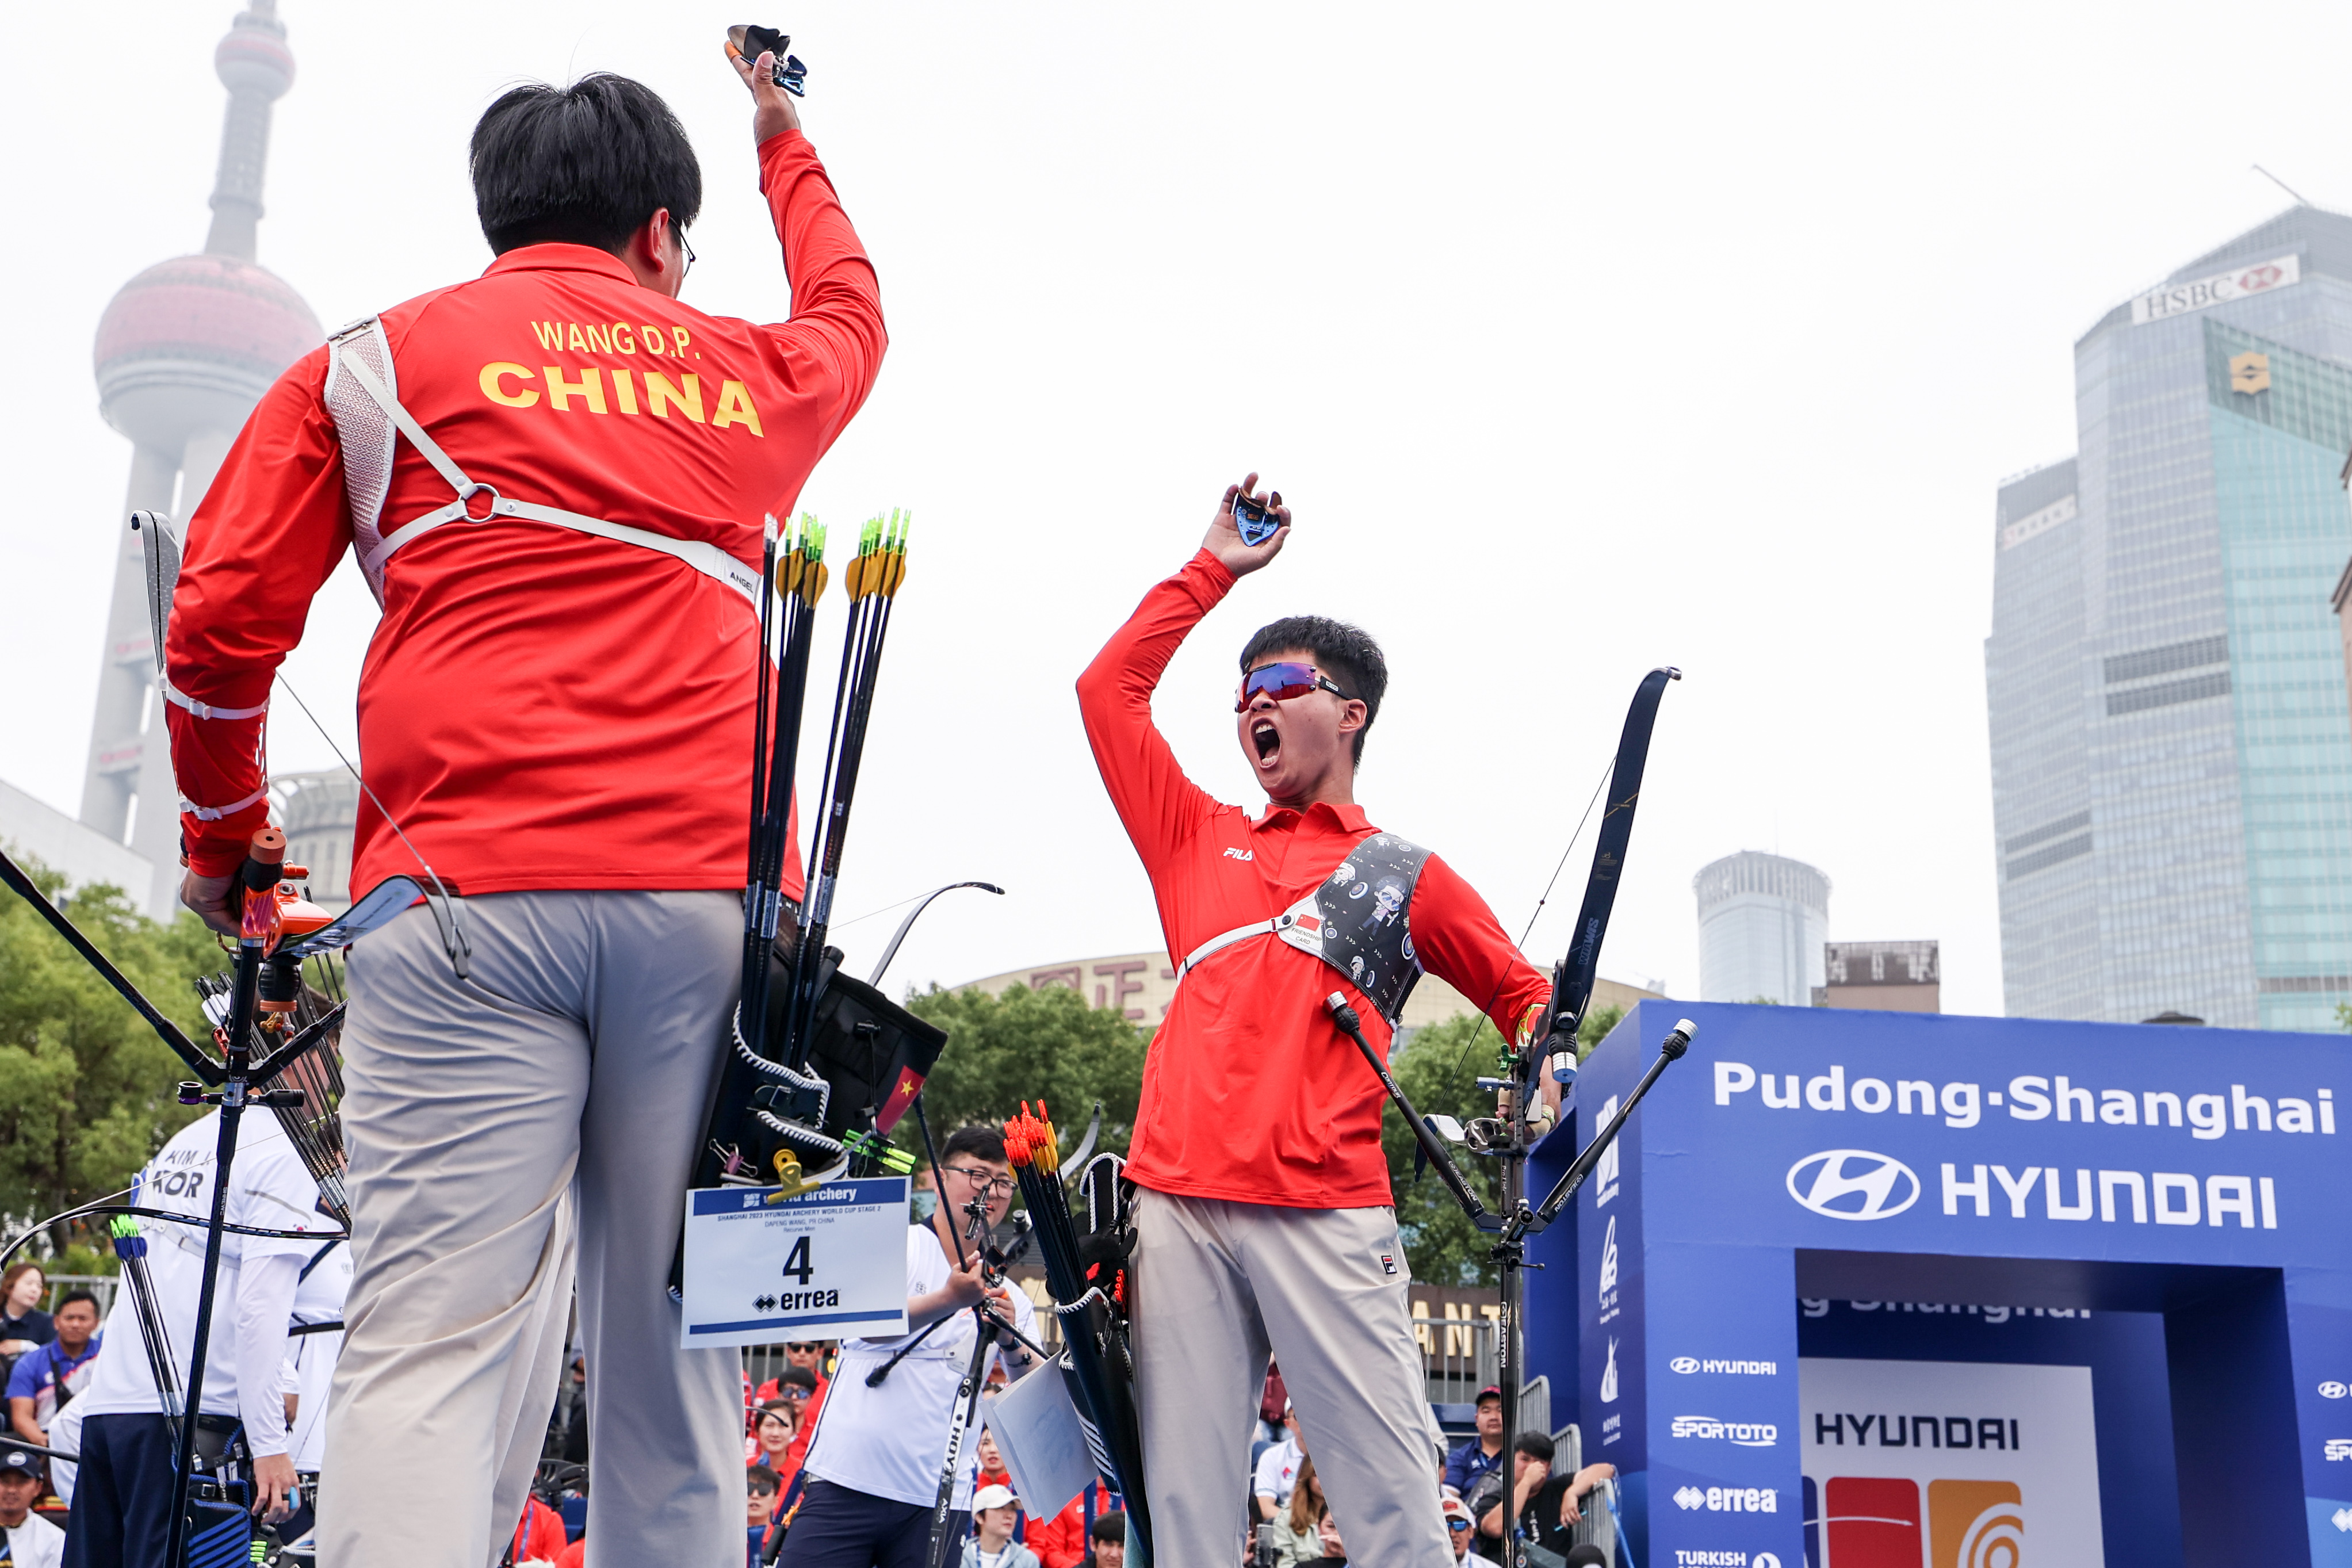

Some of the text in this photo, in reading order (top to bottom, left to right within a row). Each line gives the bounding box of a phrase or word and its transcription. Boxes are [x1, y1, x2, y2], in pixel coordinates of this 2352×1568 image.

[2147, 276, 2231, 318] HSBC
[531, 320, 701, 360] WANG D.P.
[479, 361, 765, 438] CHINA
[731, 572, 754, 594] ANGEL
[1223, 847, 1253, 861] FILA
[1291, 928, 1322, 942] FRIENDSHIP
[1295, 936, 1311, 944] CARD
[165, 1150, 198, 1165] KIM
[152, 1170, 204, 1198] KOR
[805, 1187, 857, 1203] archery
[1941, 1162, 2277, 1230] HYUNDAI
[1554, 1184, 1577, 1213] EASTON
[718, 1213, 748, 1222] SHANGHAI
[783, 1236, 813, 1286] 4
[1703, 1359, 1776, 1375] HYUNDAI
[1815, 1413, 2020, 1451] HYUNDAI
[939, 1497, 949, 1524] AXIA
[1675, 1550, 1746, 1566] TURKISH
